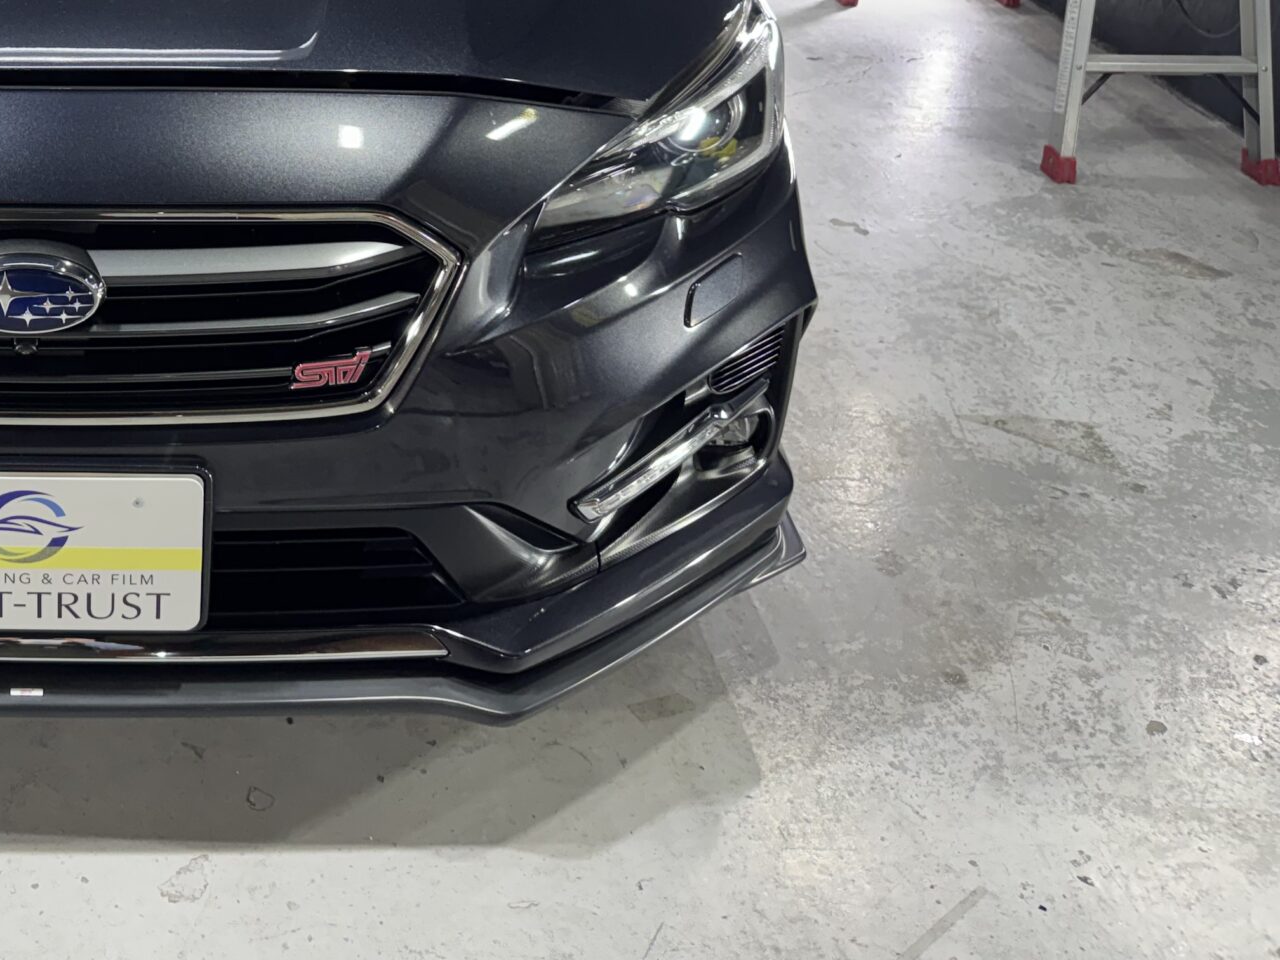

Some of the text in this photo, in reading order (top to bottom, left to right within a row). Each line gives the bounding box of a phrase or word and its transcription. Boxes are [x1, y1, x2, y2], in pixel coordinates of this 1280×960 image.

[41, 573, 53, 585] &
[62, 573, 101, 585] CAR
[111, 573, 154, 586] FILM
